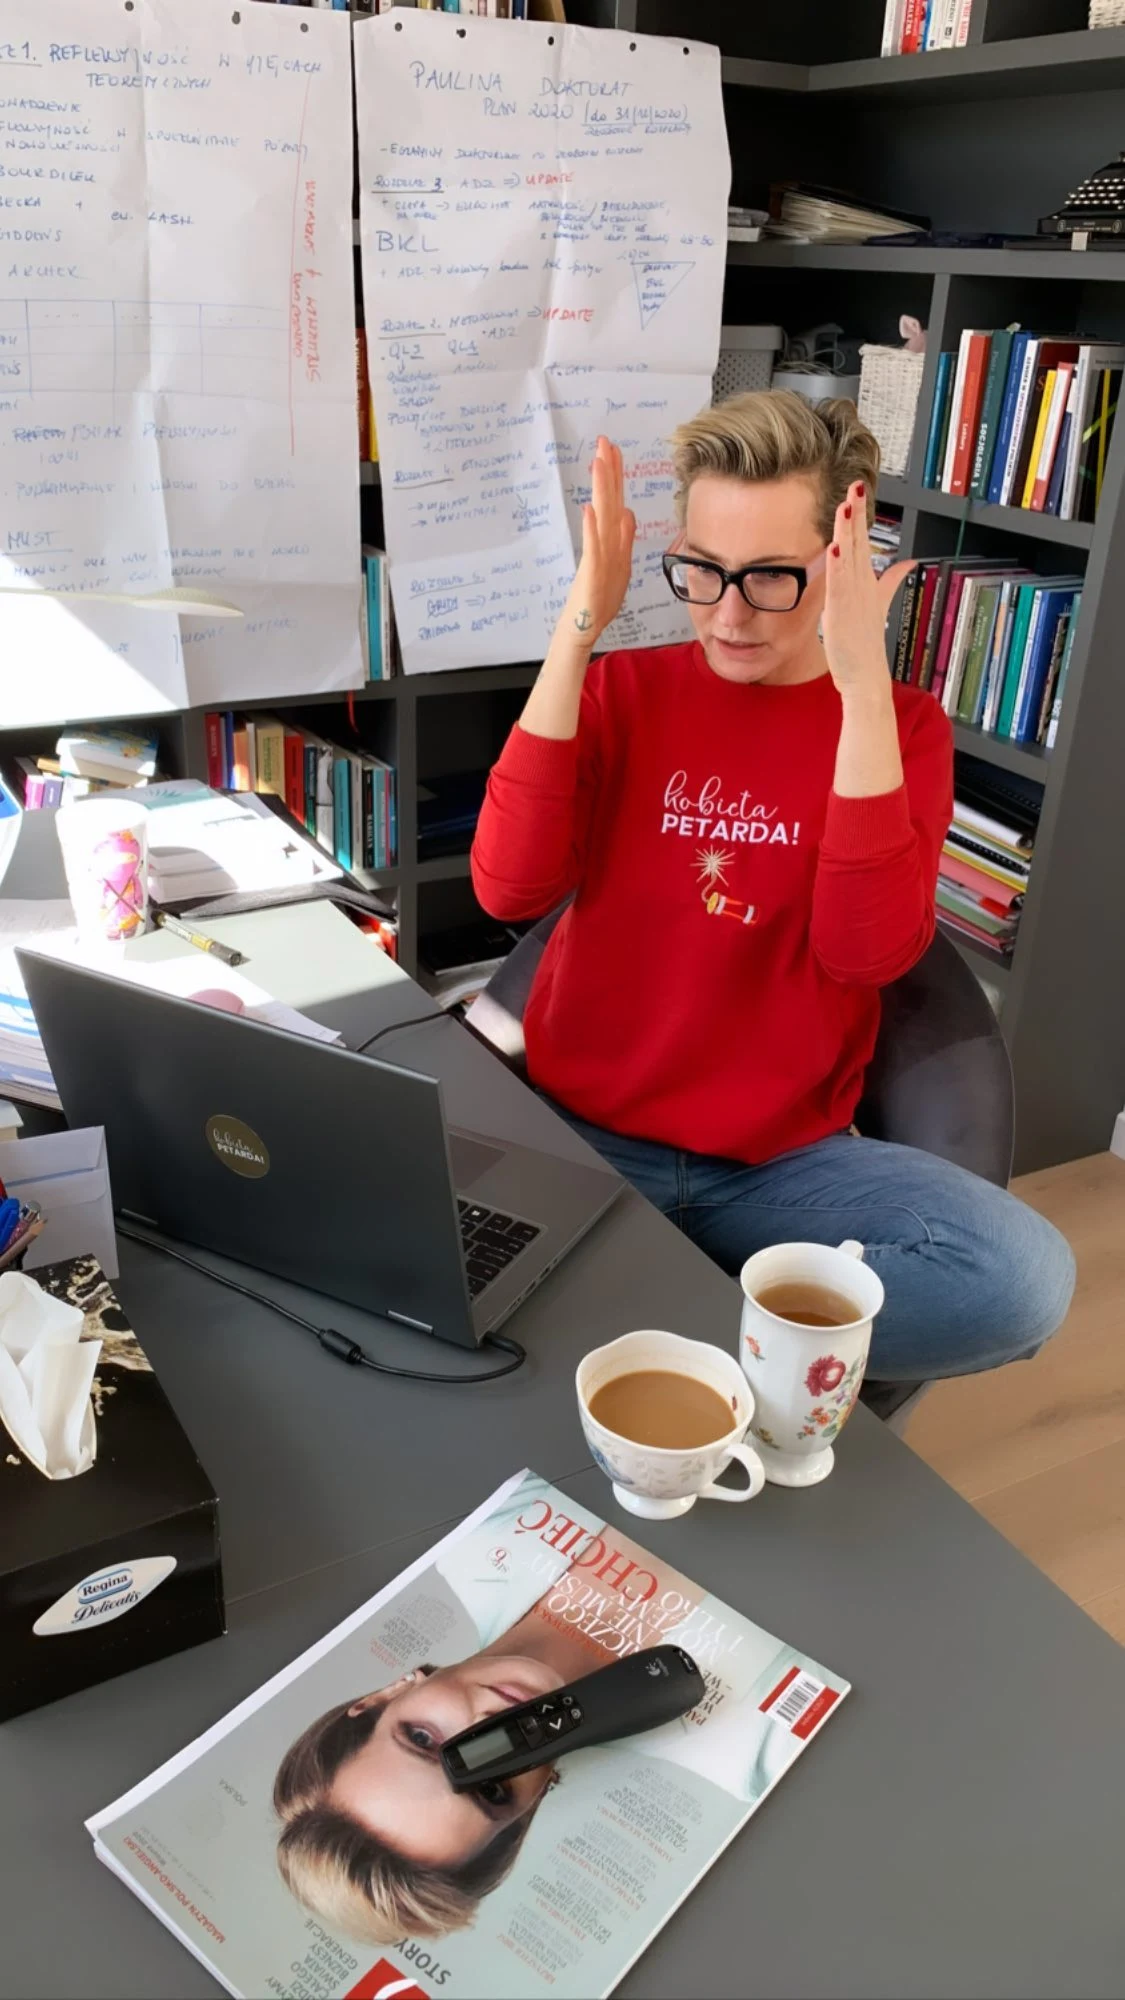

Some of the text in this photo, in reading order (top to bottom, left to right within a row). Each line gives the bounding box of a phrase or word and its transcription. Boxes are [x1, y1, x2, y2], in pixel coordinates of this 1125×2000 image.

[409, 60, 503, 93] PAULINA
[525, 171, 576, 185] UPDATE
[375, 230, 440, 254] BKL
[973, 422, 988, 478] SOCJOLOGIA
[664, 769, 778, 821] kobieta
[661, 813, 800, 845] PETARDA!
[216, 1142, 265, 1165] PETARDA!
[513, 1500, 659, 1602] CHCIEĆ
[82, 1574, 128, 1597] Regina
[520, 1549, 614, 1617] MUSIMY
[605, 1606, 654, 1645] NIE
[121, 1834, 191, 1907] POLSKO-ANGIELSKI
[187, 1903, 227, 1945] MAGAZYN
[302, 1916, 359, 1971] GENERACJE
[307, 1940, 349, 1981] BIZNESY
[392, 1933, 452, 1987] STORY
